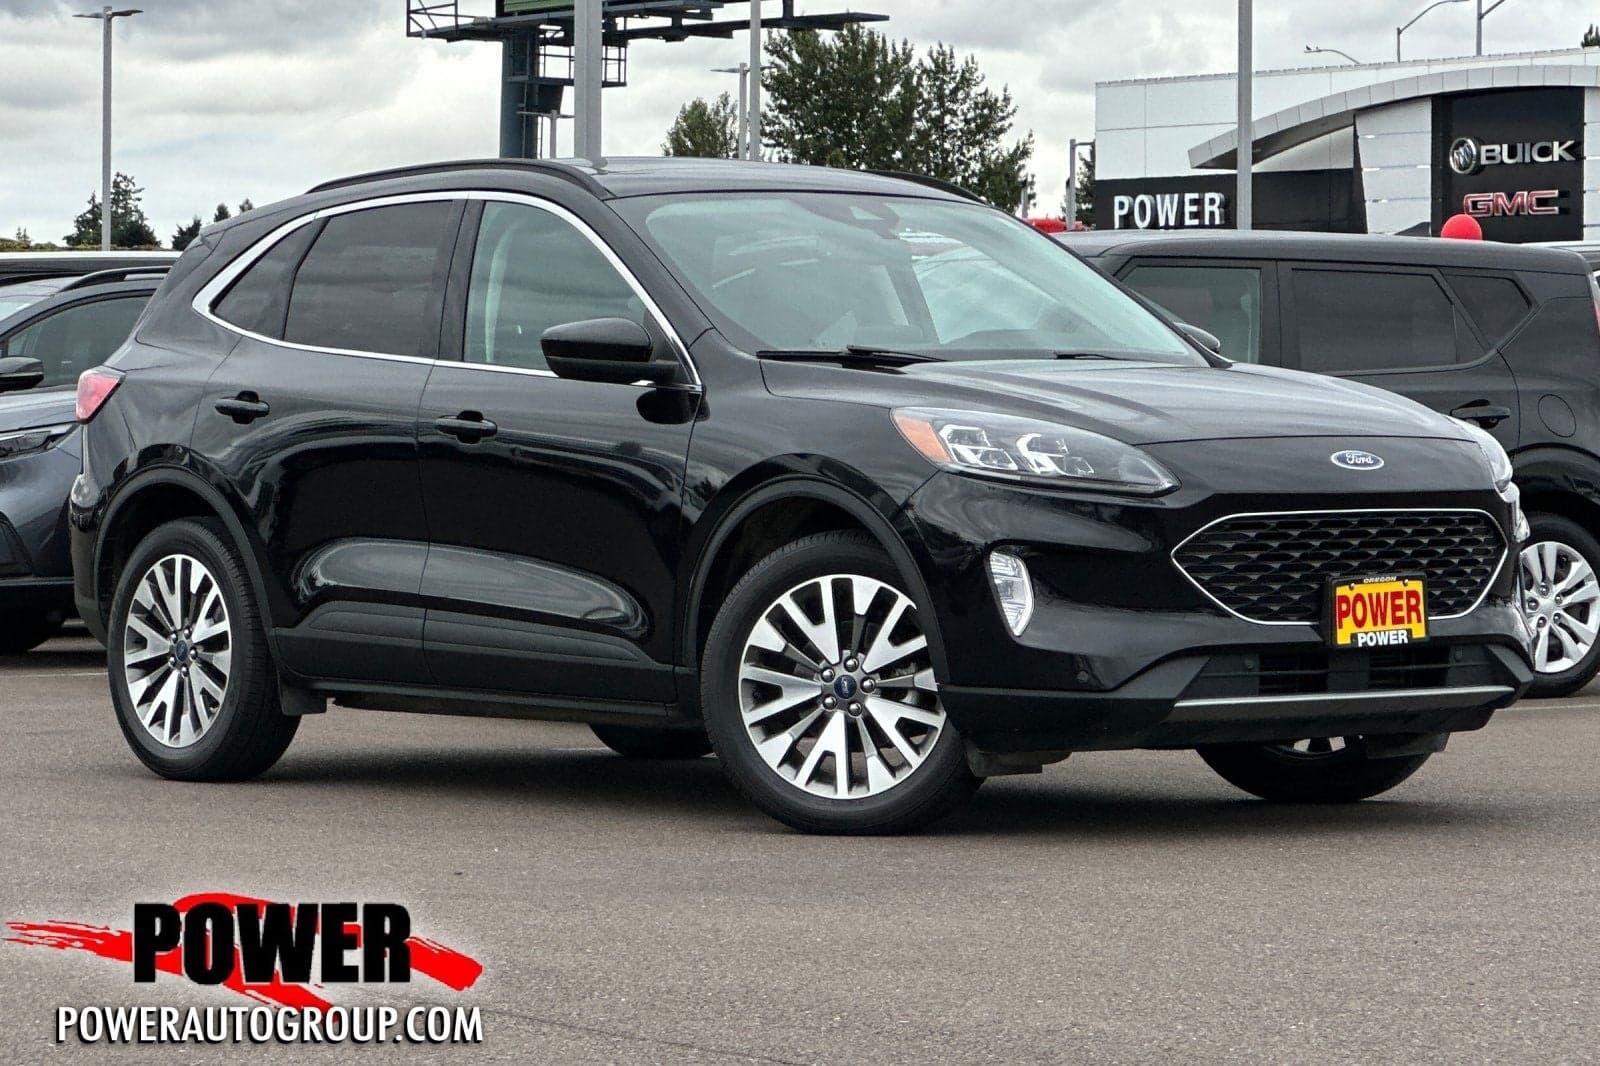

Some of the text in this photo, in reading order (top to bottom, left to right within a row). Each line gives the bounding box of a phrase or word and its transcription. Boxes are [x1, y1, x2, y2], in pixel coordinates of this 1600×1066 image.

[1480, 140, 1576, 165] BUICK
[1113, 192, 1225, 229] POWER
[1463, 189, 1559, 217] GMC
[1363, 576, 1397, 584] OREGON
[1337, 590, 1422, 630] POWER
[1357, 629, 1408, 647] POWER
